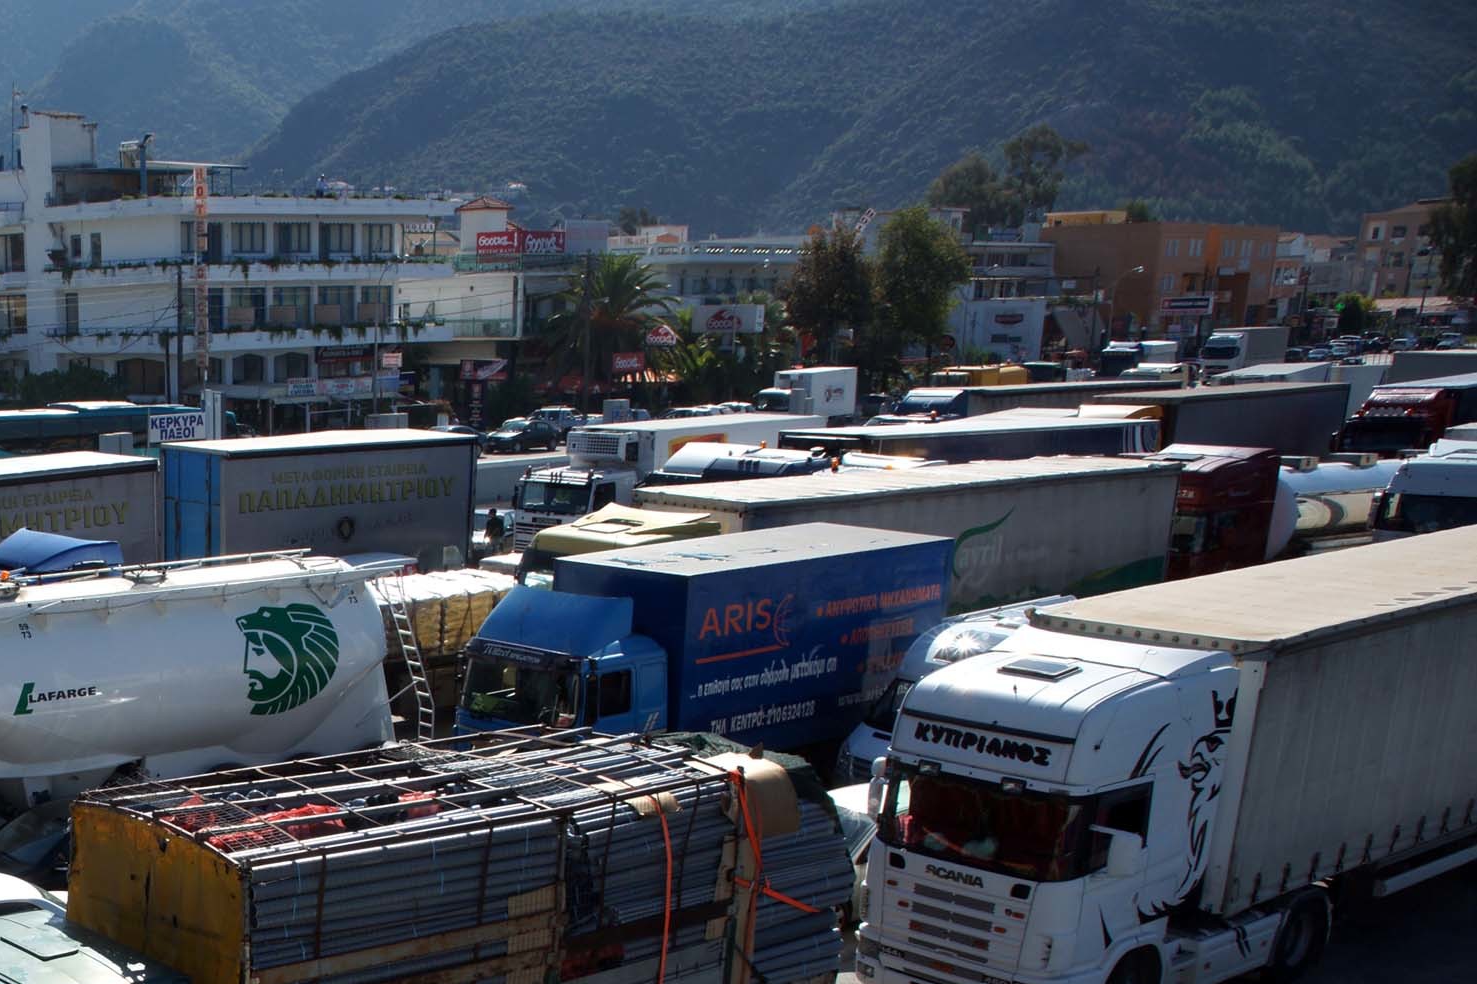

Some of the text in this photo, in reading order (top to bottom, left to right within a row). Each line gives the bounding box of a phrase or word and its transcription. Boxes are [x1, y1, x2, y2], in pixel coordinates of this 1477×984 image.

[150, 415, 204, 430] ΚΕΡΚΥΡΑ
[160, 427, 195, 441] ΠΑΞΟΙ
[238, 476, 455, 513] ΠΑΠΑΔΗΜΗΤΡΙΟΥ
[699, 598, 773, 640] ARIS
[27, 686, 97, 704] LAFARGE
[915, 722, 1052, 767] ΚΥΠΡΙΑΝΟΣ
[926, 863, 984, 889] SCANIA
